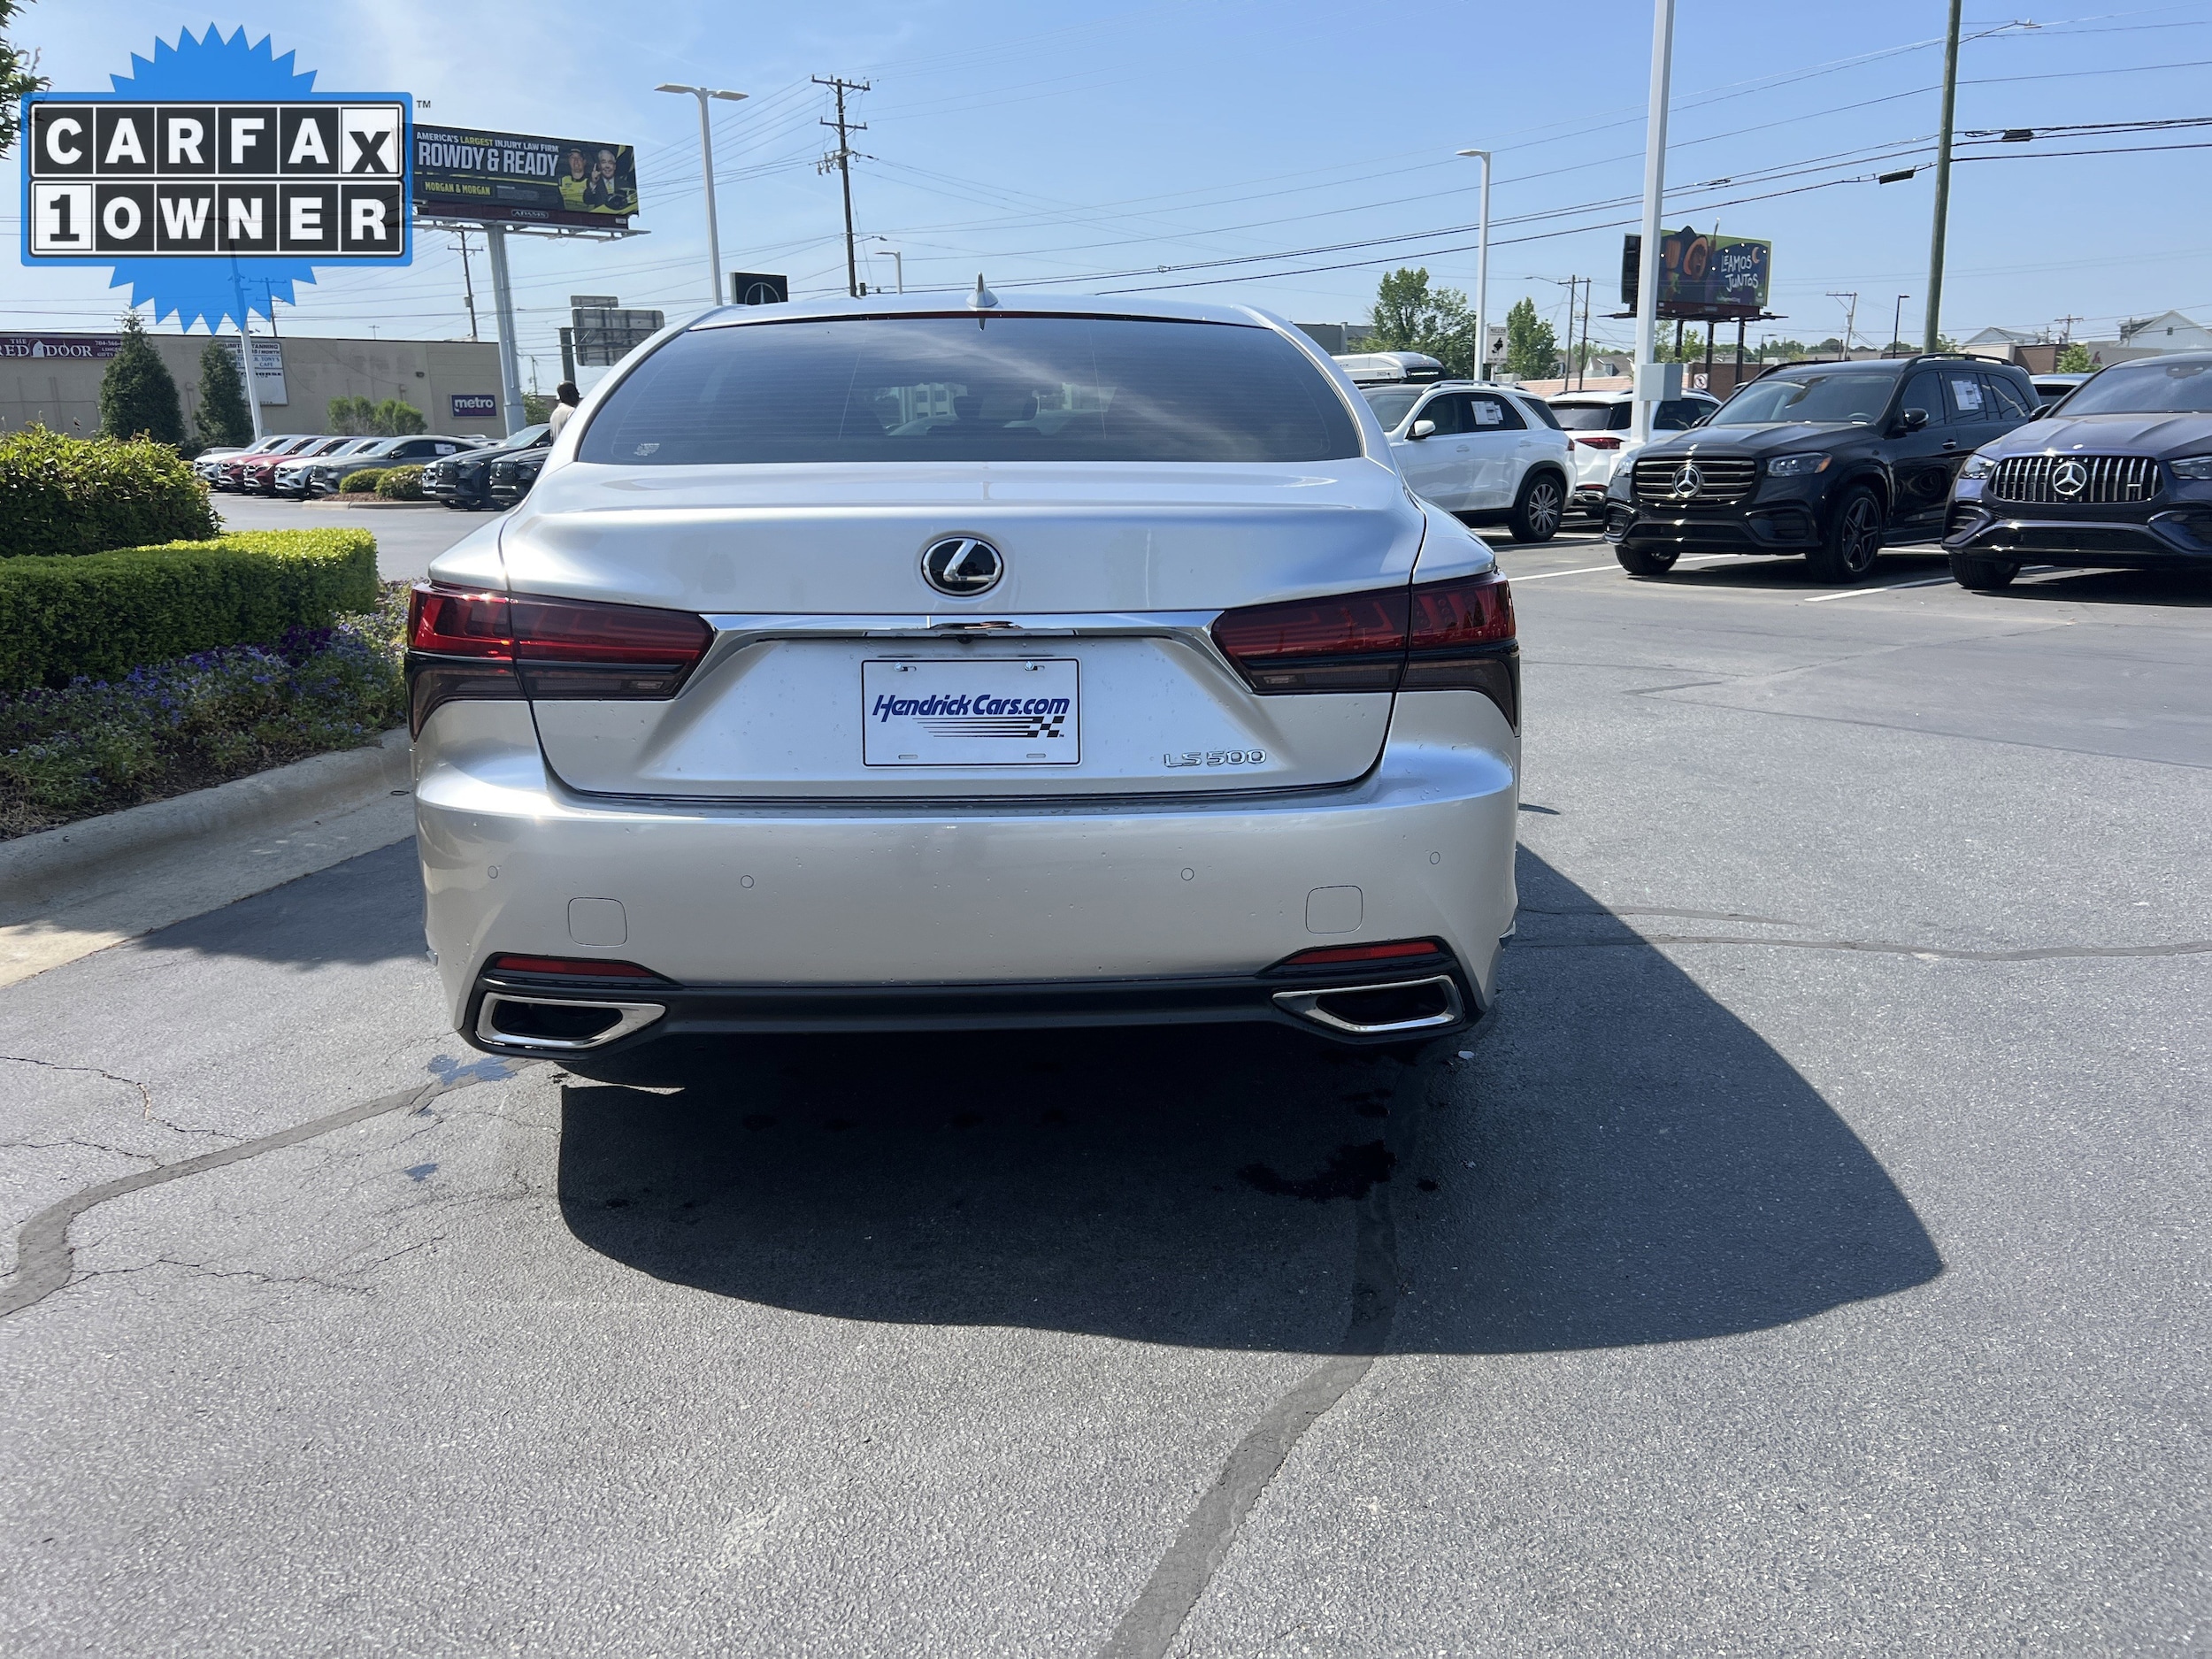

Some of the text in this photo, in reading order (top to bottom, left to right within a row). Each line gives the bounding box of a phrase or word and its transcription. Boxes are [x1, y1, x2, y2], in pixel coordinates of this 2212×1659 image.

[416, 132, 559, 153] AMERICA'S LARGEST INJURY LAW FIRM
[419, 142, 559, 176] ROWDY & READY
[425, 181, 455, 193] MORGAN
[456, 183, 461, 194] &
[462, 184, 491, 196] MORGAN
[1721, 255, 1753, 273] LEAMOS
[42, 344, 93, 357] DOOR
[454, 396, 495, 409] metro
[1164, 749, 1266, 768] LS 500
